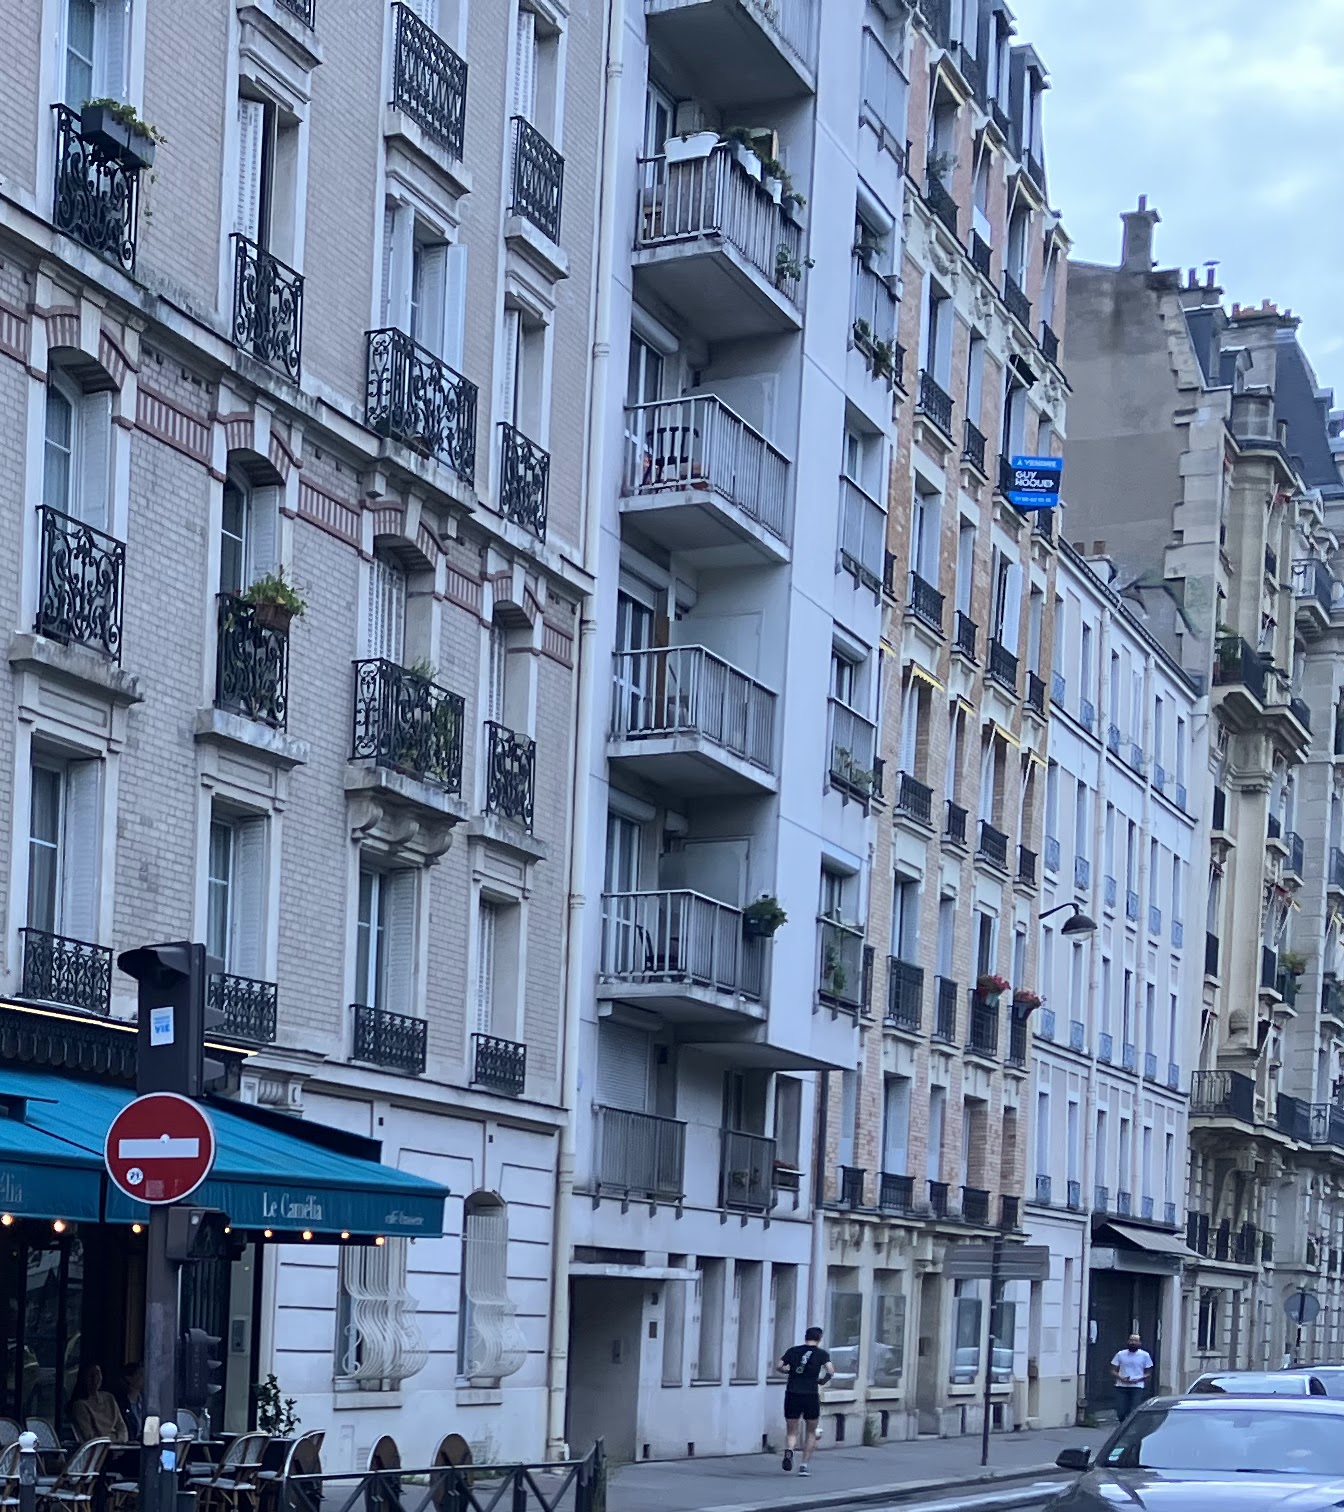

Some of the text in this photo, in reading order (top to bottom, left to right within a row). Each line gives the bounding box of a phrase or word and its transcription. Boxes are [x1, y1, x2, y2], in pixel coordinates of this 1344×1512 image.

[1015, 470, 1037, 479] GUY
[263, 1191, 323, 1220] Le Camélia
